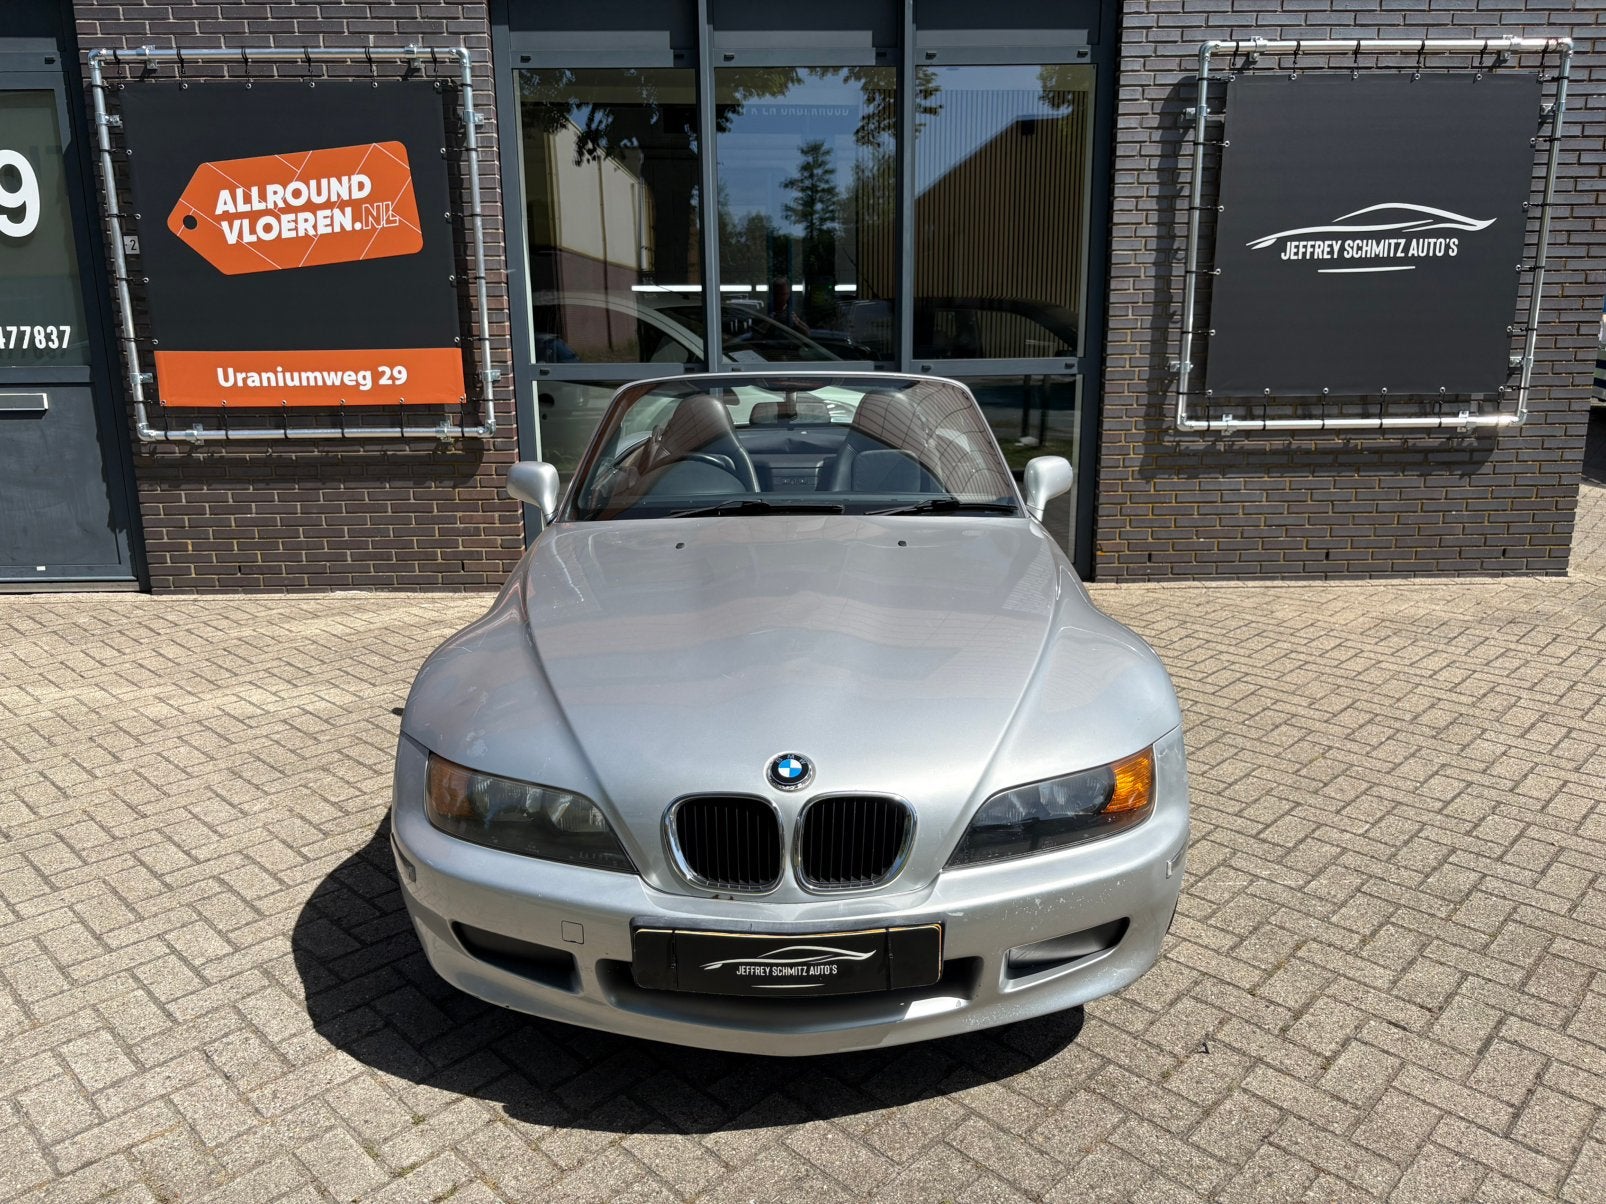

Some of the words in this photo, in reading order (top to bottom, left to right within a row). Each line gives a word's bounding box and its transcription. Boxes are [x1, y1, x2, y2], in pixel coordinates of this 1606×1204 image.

[214, 173, 372, 216] ALLROUND
[220, 201, 400, 245] VLOEREN.NL
[1280, 240, 1342, 260] JEFFREY
[1343, 238, 1406, 259] SCHMITZ
[1408, 237, 1459, 257] AUTO'S
[216, 366, 373, 391] Uraniumweg
[377, 365, 408, 386] 29
[736, 965, 771, 976] JEFFREY
[771, 965, 808, 976] SCHMITZ
[809, 964, 838, 976] AUTO'S
